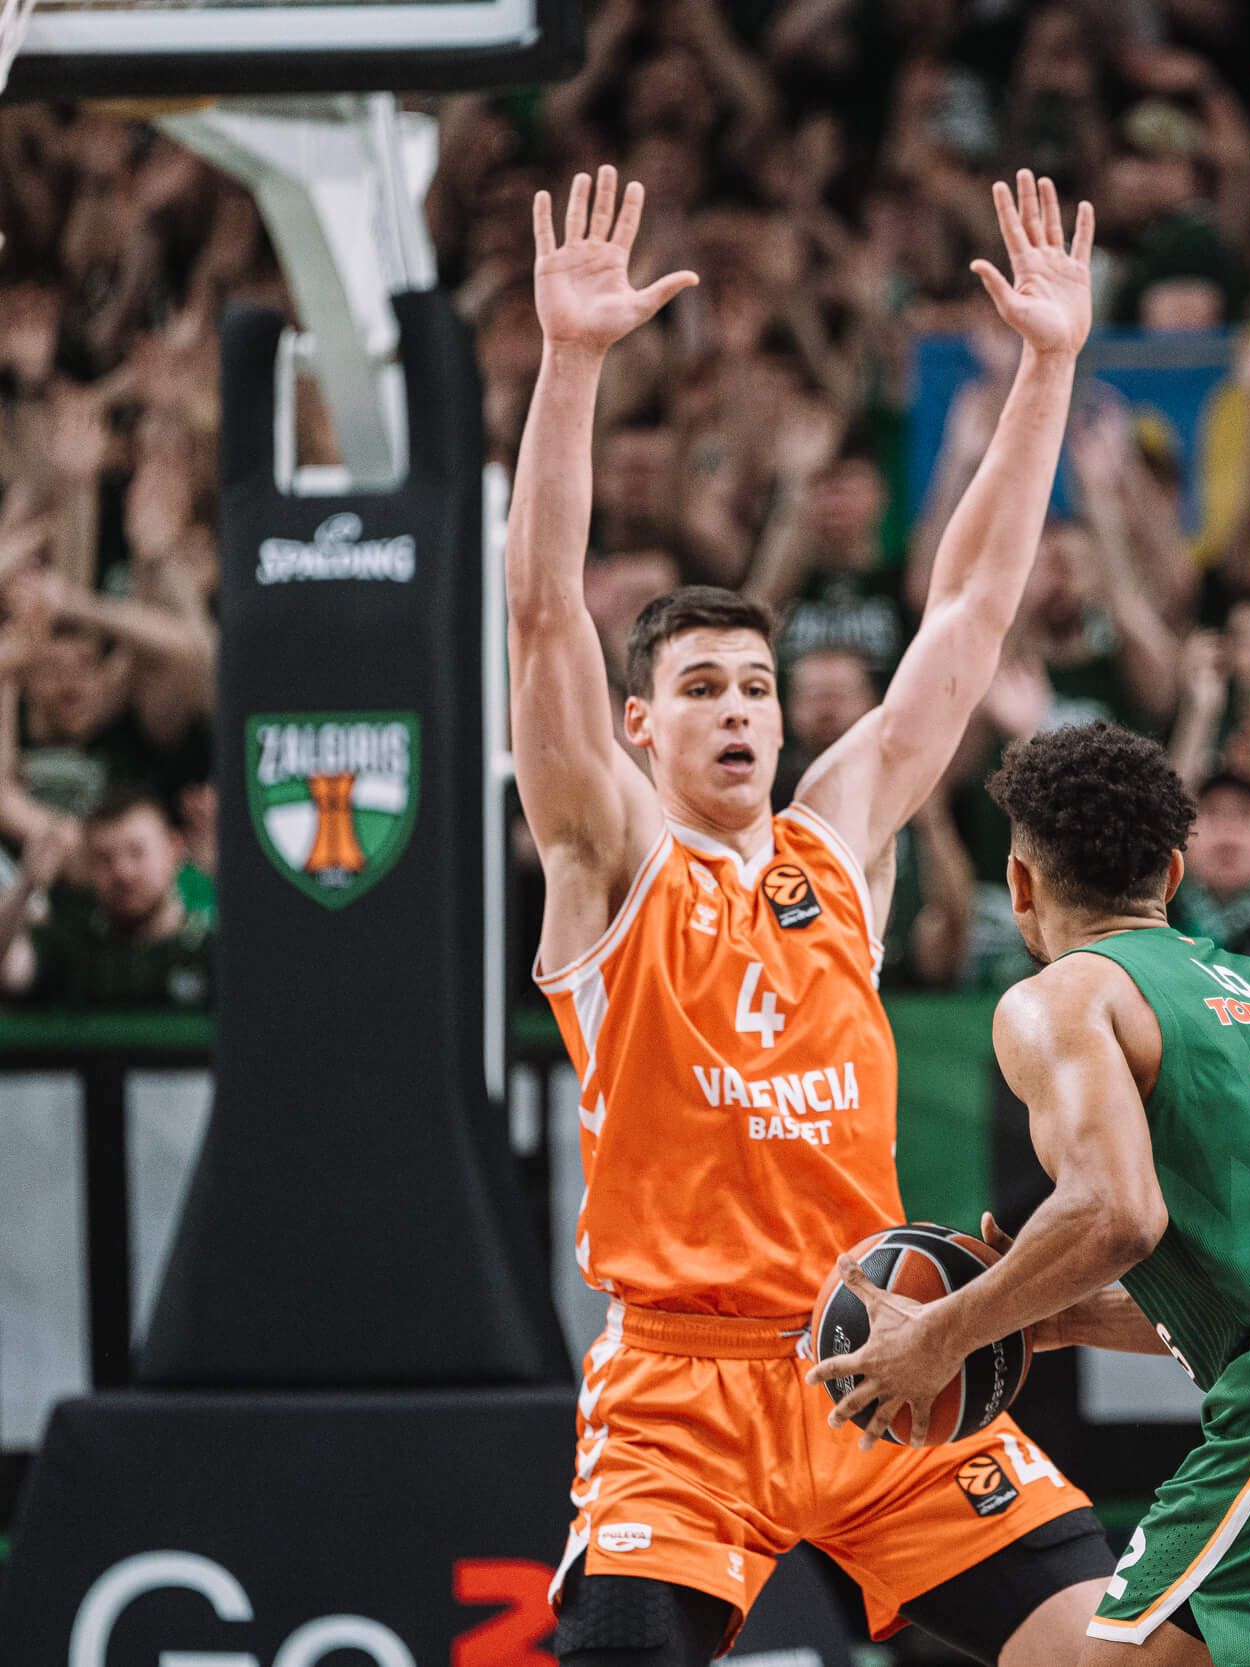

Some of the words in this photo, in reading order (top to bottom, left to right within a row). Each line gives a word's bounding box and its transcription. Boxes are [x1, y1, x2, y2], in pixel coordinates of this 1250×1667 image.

[736, 962, 785, 1048] 4
[692, 1061, 860, 1116] VAENCIA
[749, 1115, 833, 1145] BASET
[996, 1433, 1066, 1488] 4
